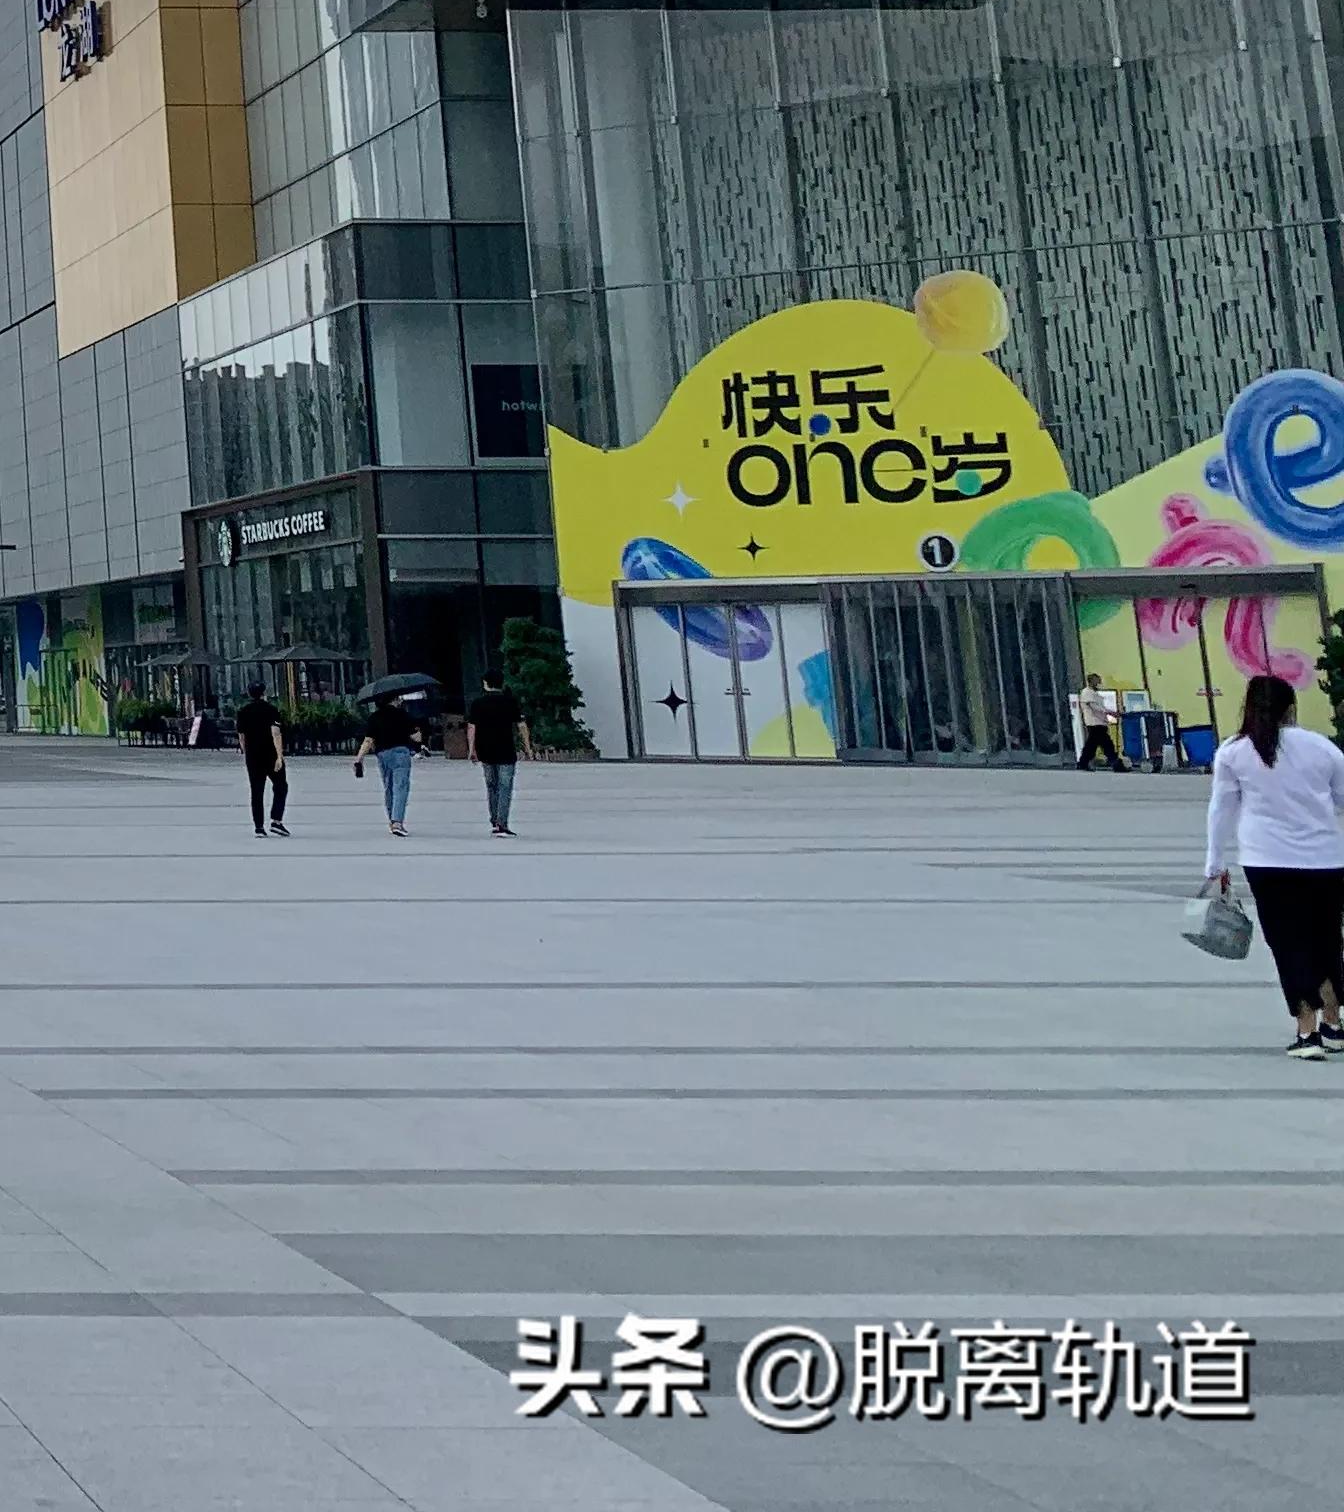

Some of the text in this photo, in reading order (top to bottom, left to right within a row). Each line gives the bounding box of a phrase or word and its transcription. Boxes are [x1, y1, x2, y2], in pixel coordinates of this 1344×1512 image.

[722, 365, 895, 437] 快乐
[241, 510, 325, 545] STARBUCKS COFFEE
